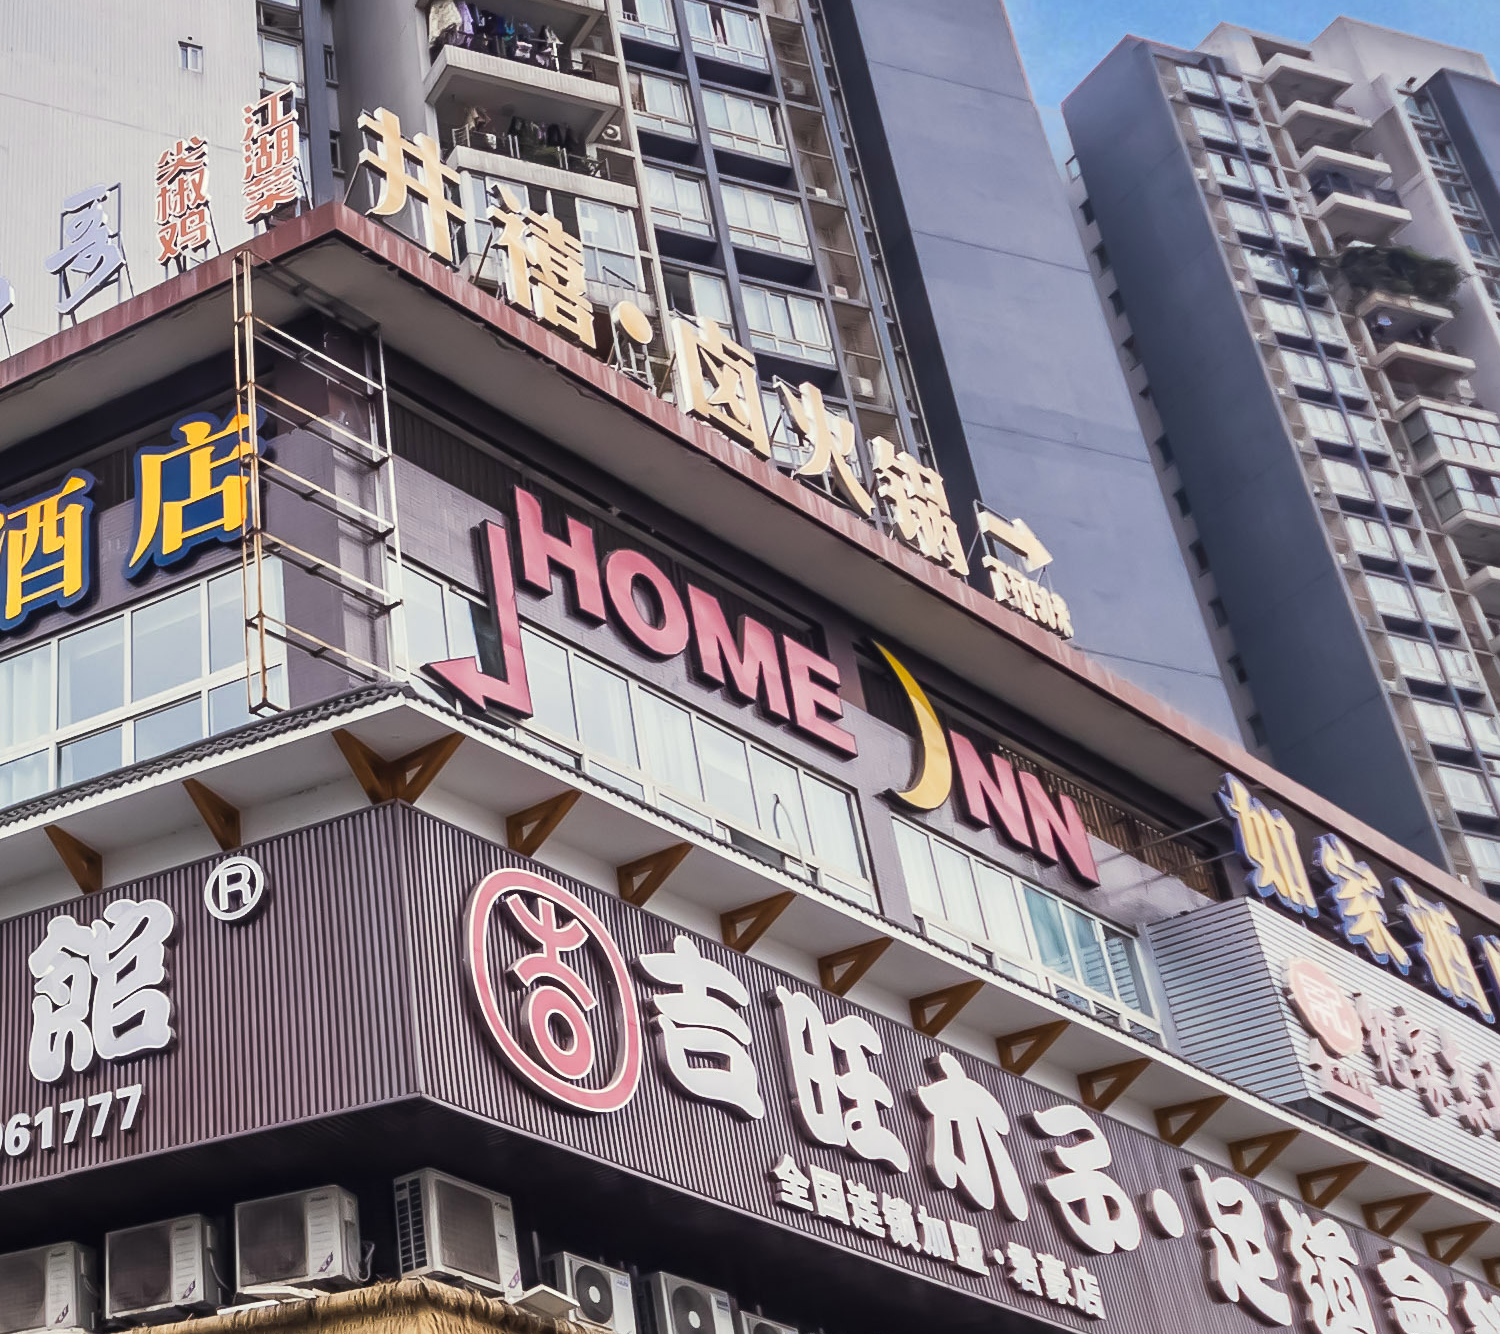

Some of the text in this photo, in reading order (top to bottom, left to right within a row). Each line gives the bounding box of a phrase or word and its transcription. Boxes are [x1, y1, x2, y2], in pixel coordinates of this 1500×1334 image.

[155, 135, 210, 264] 尖椒鸡
[241, 81, 300, 223] 江湖菜
[512, 485, 858, 759] HOME
